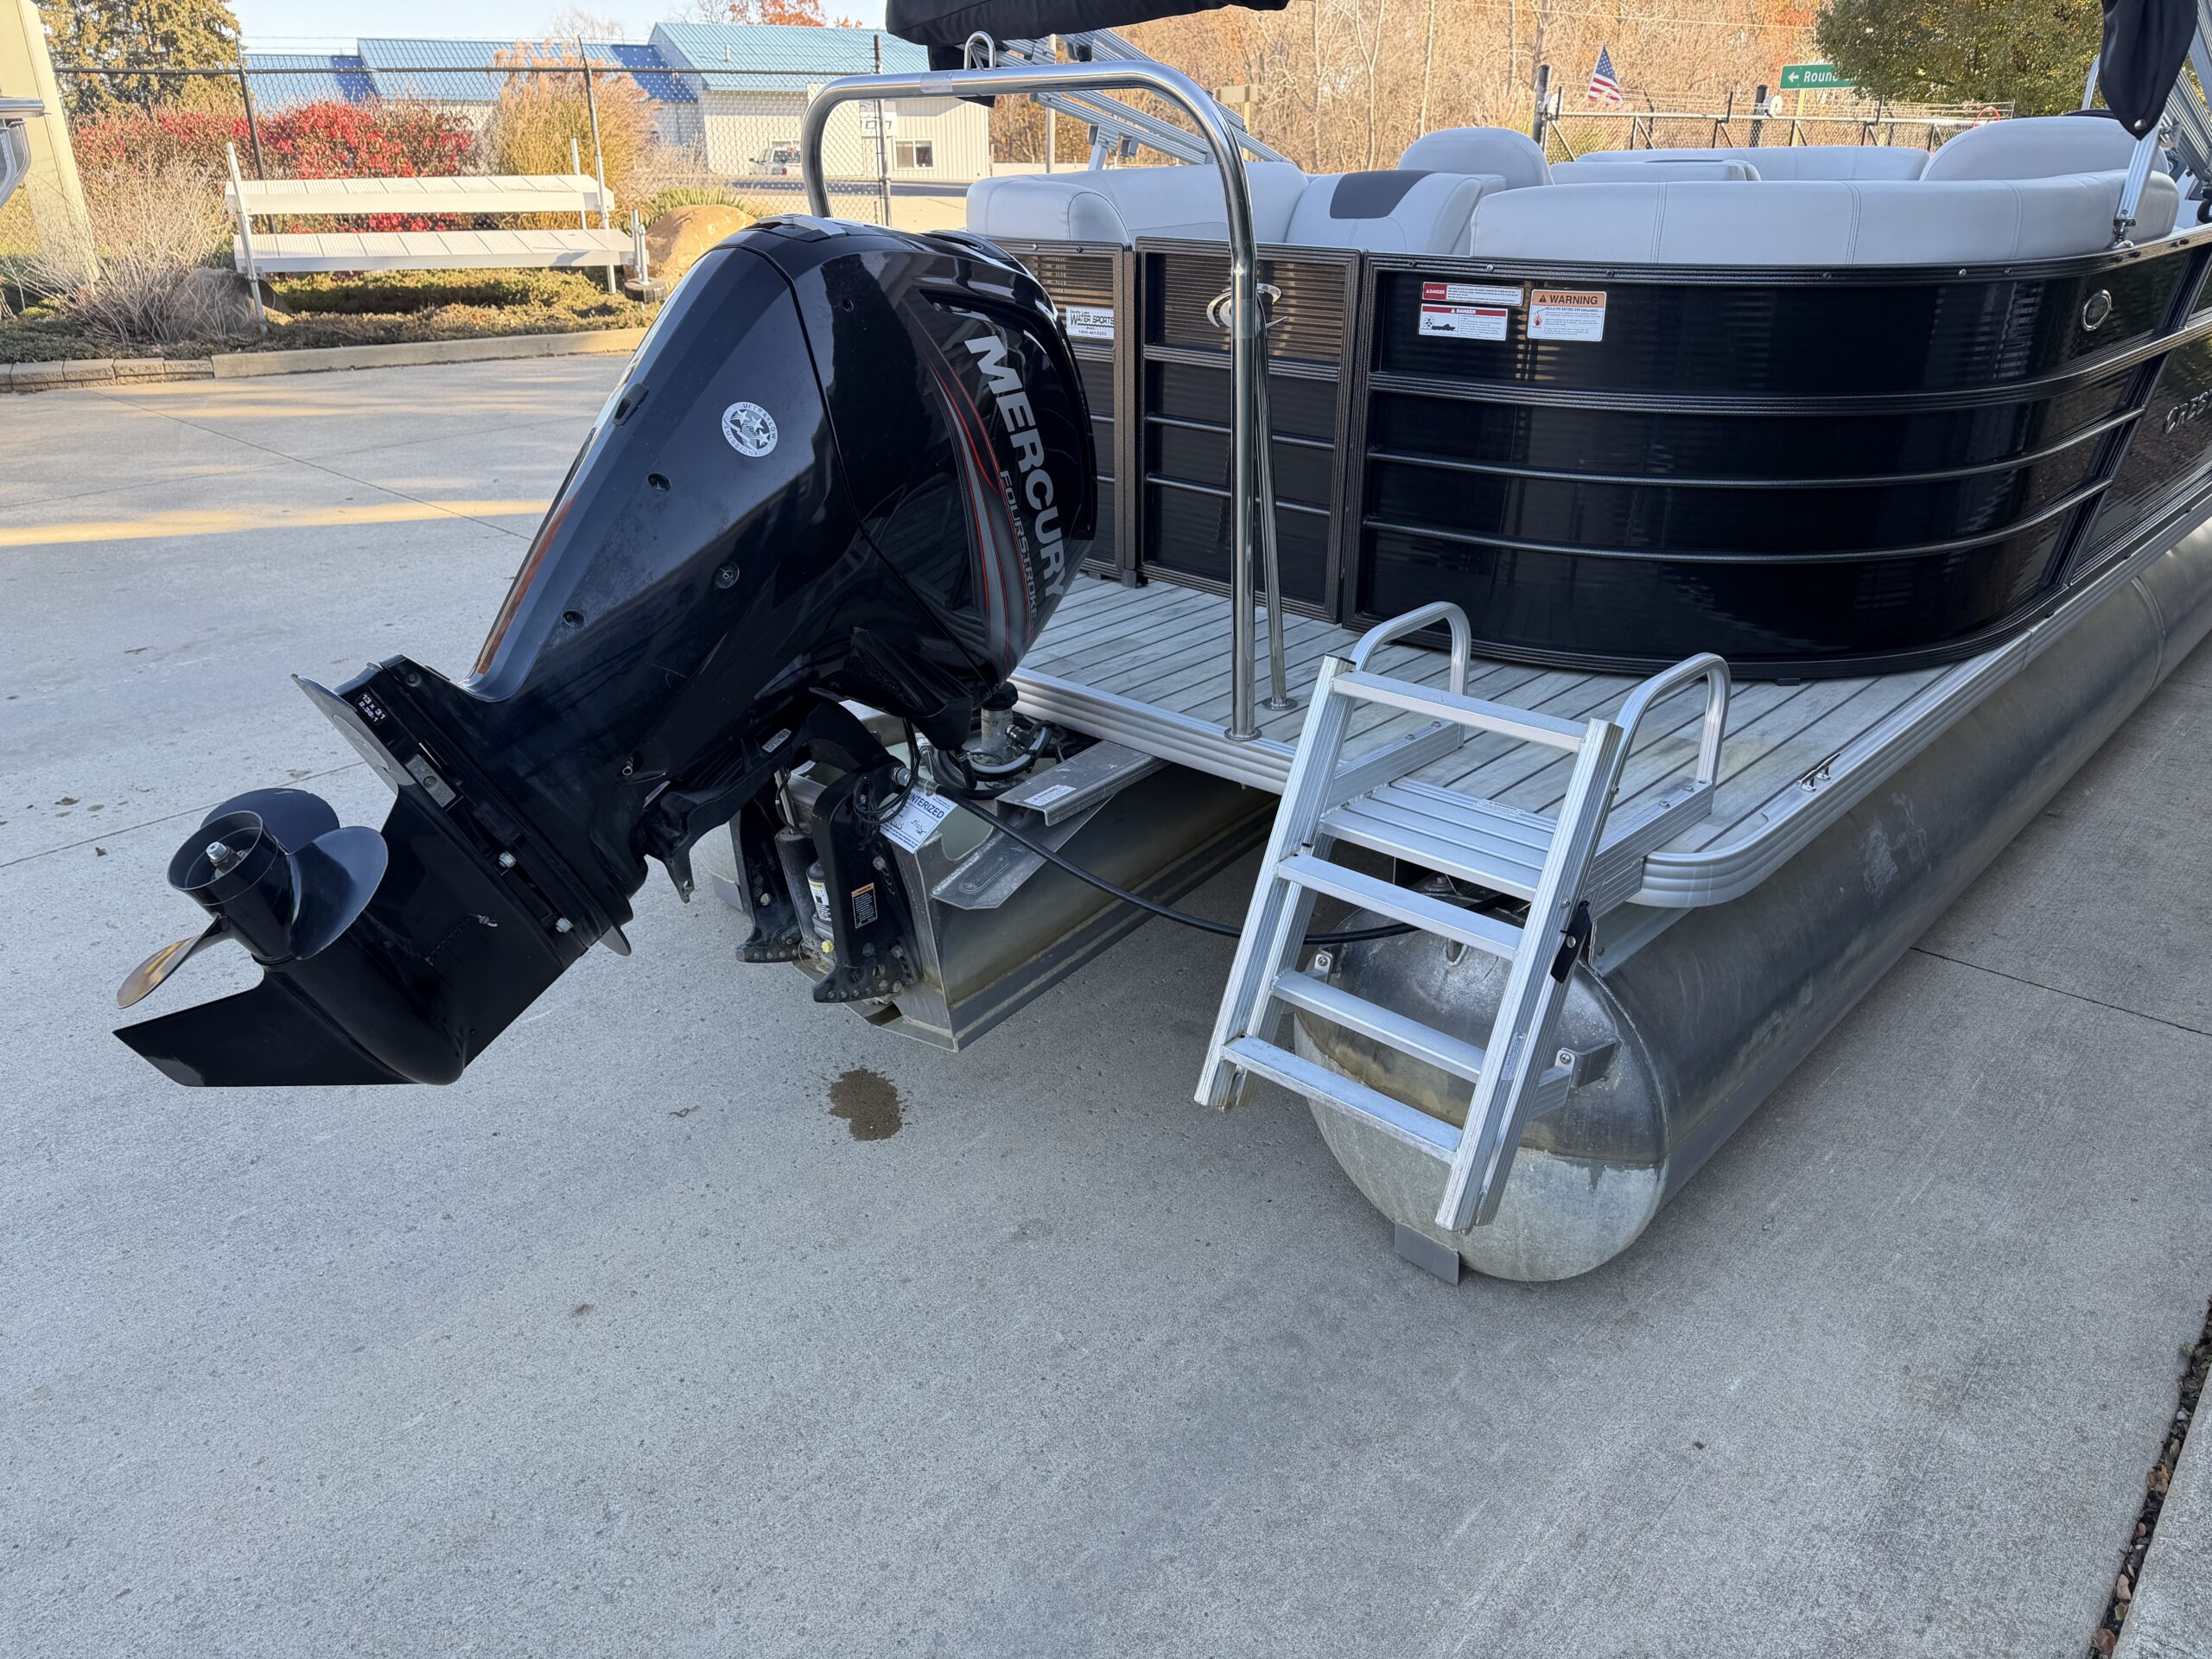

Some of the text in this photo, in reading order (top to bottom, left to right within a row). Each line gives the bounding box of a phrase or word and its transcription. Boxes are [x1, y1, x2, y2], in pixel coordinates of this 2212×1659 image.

[1549, 295, 1599, 305] WARNING
[1071, 314, 1114, 325] WATER SPORTS
[743, 403, 767, 418] ULTRA
[768, 422, 777, 440] LOW
[2164, 388, 2212, 434] CRES
[963, 334, 1065, 598] MERCURY
[999, 470, 1037, 622] FOURSTROKE
[363, 694, 372, 704] 13
[374, 709, 386, 720] 31
[909, 791, 945, 819] INTERIZED
